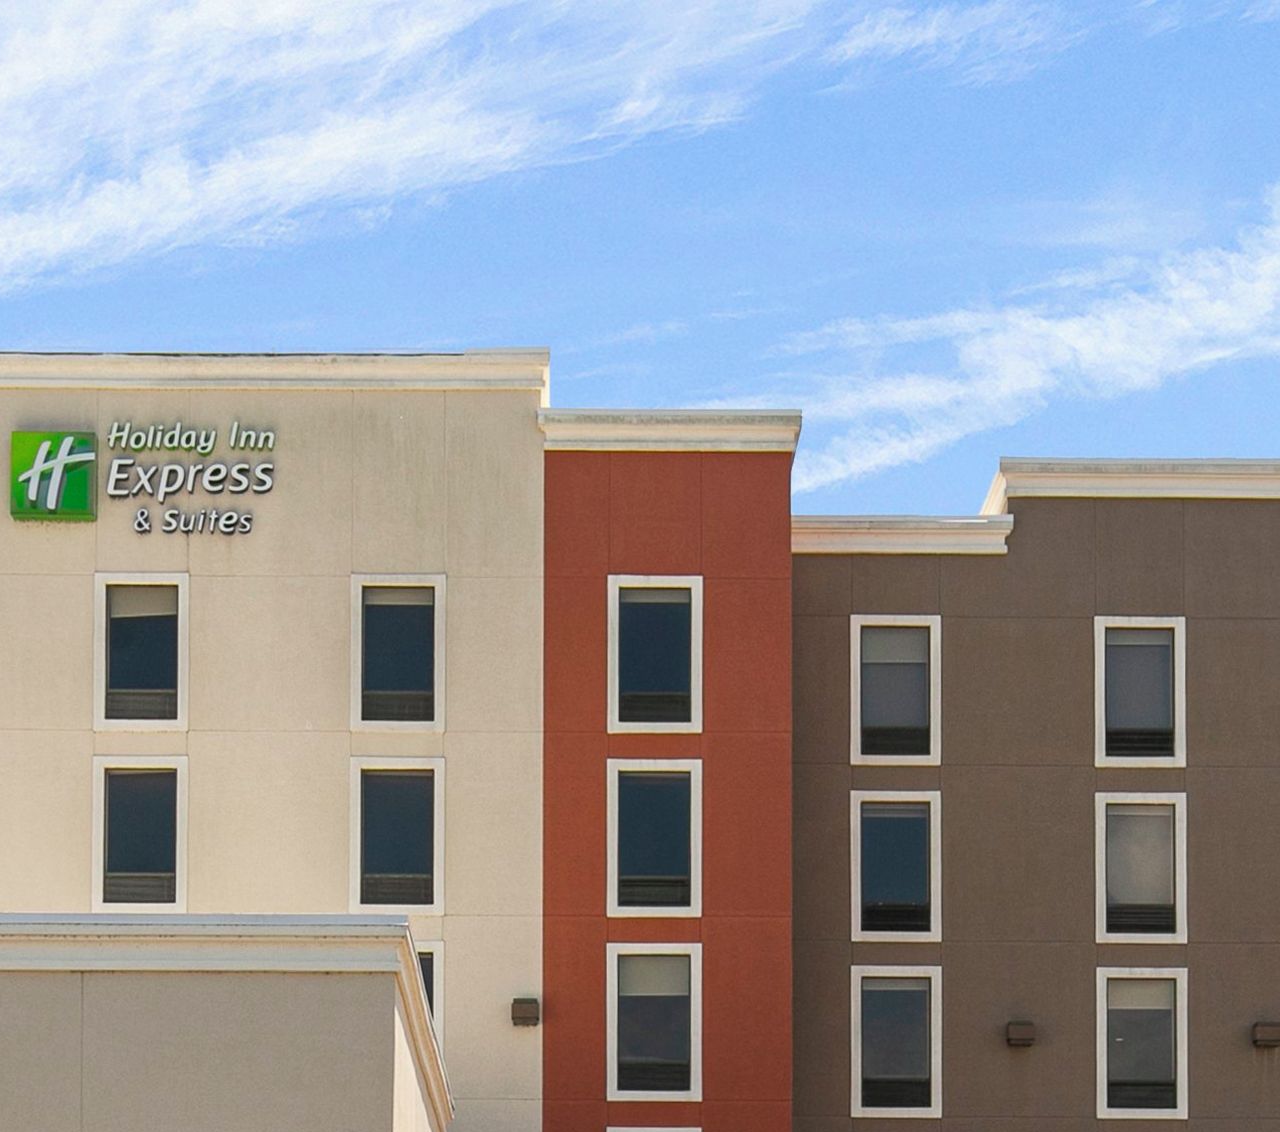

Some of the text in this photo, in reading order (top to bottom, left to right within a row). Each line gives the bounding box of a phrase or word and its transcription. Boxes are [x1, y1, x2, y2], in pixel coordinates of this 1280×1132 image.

[107, 421, 275, 454] Holiday Inn
[106, 457, 274, 503] Express
[133, 508, 253, 534] & Suites
